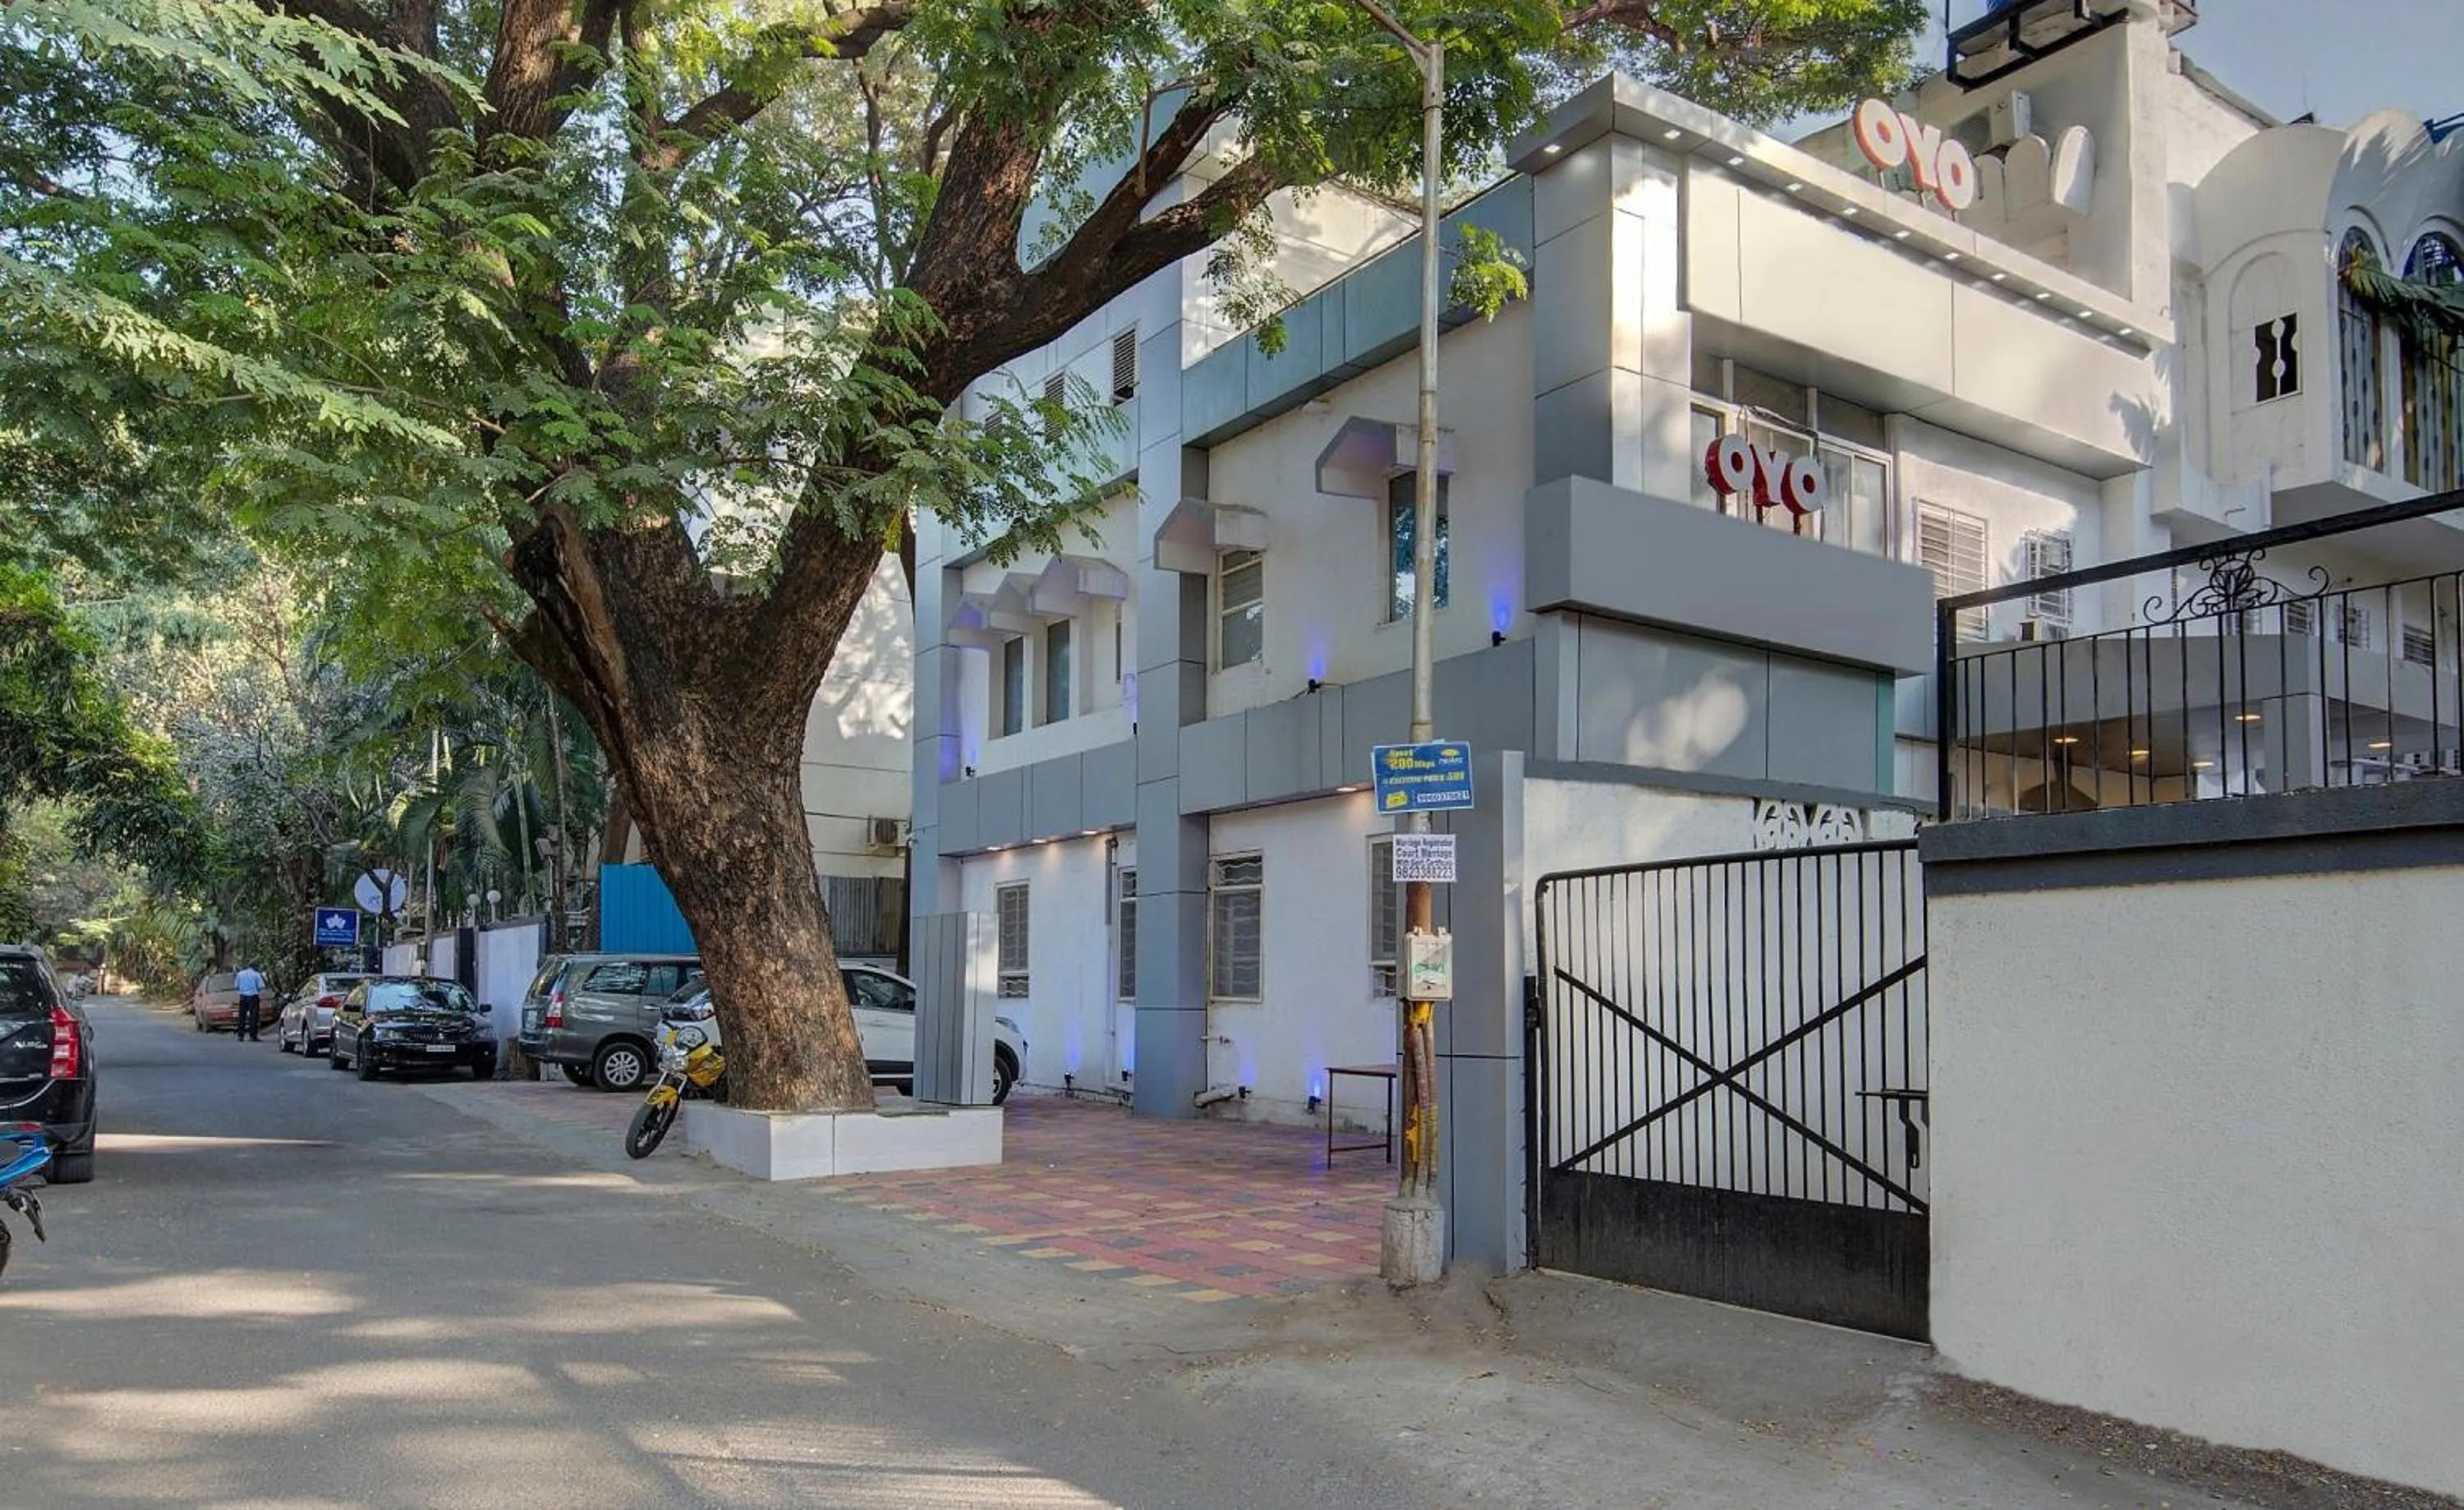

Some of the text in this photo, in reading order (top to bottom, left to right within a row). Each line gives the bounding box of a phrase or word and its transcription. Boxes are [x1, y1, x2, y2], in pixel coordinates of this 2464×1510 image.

[1854, 98, 1974, 211] OYO
[1705, 433, 1827, 515] OYO
[1396, 848, 1453, 859] Court Marriage
